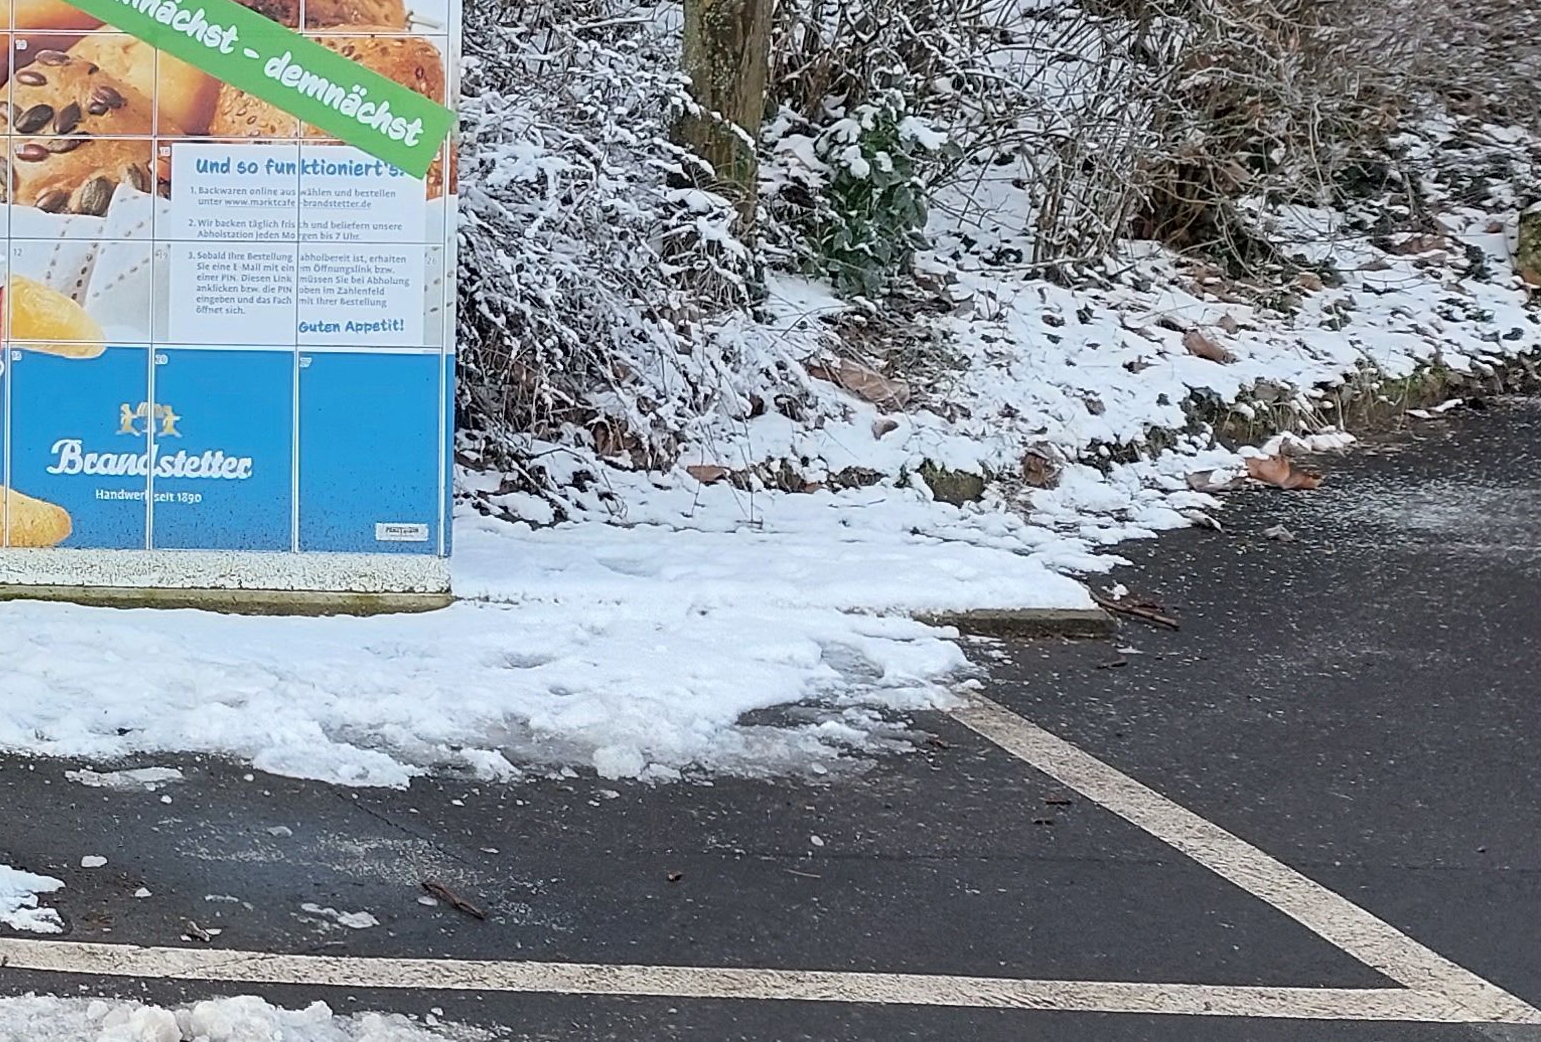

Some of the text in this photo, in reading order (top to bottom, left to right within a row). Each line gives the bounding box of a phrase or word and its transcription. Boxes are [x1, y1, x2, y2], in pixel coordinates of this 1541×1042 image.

[263, 52, 426, 148] demnächst
[196, 156, 231, 175] Und
[236, 160, 259, 175] so
[190, 186, 197, 195] 1.
[198, 186, 247, 196] Backwaren
[249, 187, 278, 196] online
[334, 188, 352, 197] und
[354, 188, 396, 198] bestellen
[198, 198, 222, 206] unter
[188, 218, 196, 227] 2.
[197, 218, 213, 227] Wir
[215, 219, 247, 227] backen
[248, 219, 279, 230] täglich
[310, 220, 329, 229] und
[330, 220, 370, 230] beliefern
[196, 230, 254, 239] Abholstation
[255, 230, 280, 240] jeden
[320, 231, 334, 240] bis
[188, 251, 407, 264] 3. Sobald Ihre Bestellung abholbereit ist, erhalten
[196, 262, 210, 271] Sie
[212, 263, 231, 271] eine
[263, 263, 279, 272] mit
[313, 263, 373, 275] Öffnungslink
[374, 265, 395, 274] bzw.
[196, 274, 218, 282] einer
[241, 274, 271, 283] Diesen
[273, 274, 292, 283] Link
[299, 275, 334, 284] müssen
[335, 276, 349, 284] Sie
[350, 276, 365, 285] bei
[367, 276, 410, 288] Abholung
[196, 284, 239, 293] anklicken
[262, 284, 276, 294] die
[277, 285, 293, 294] PIN
[299, 285, 321, 294] oben
[323, 286, 335, 295] im
[336, 286, 385, 295] Zahlenfeld
[196, 296, 387, 309] eingeben und das Fach mit Ihrer Bestellung
[195, 305, 246, 315] öffnet sich.
[298, 318, 405, 335] Guten Appetit!
[45, 437, 253, 480] Brandstetter
[153, 490, 176, 503] seit
[176, 491, 203, 504] 1890
